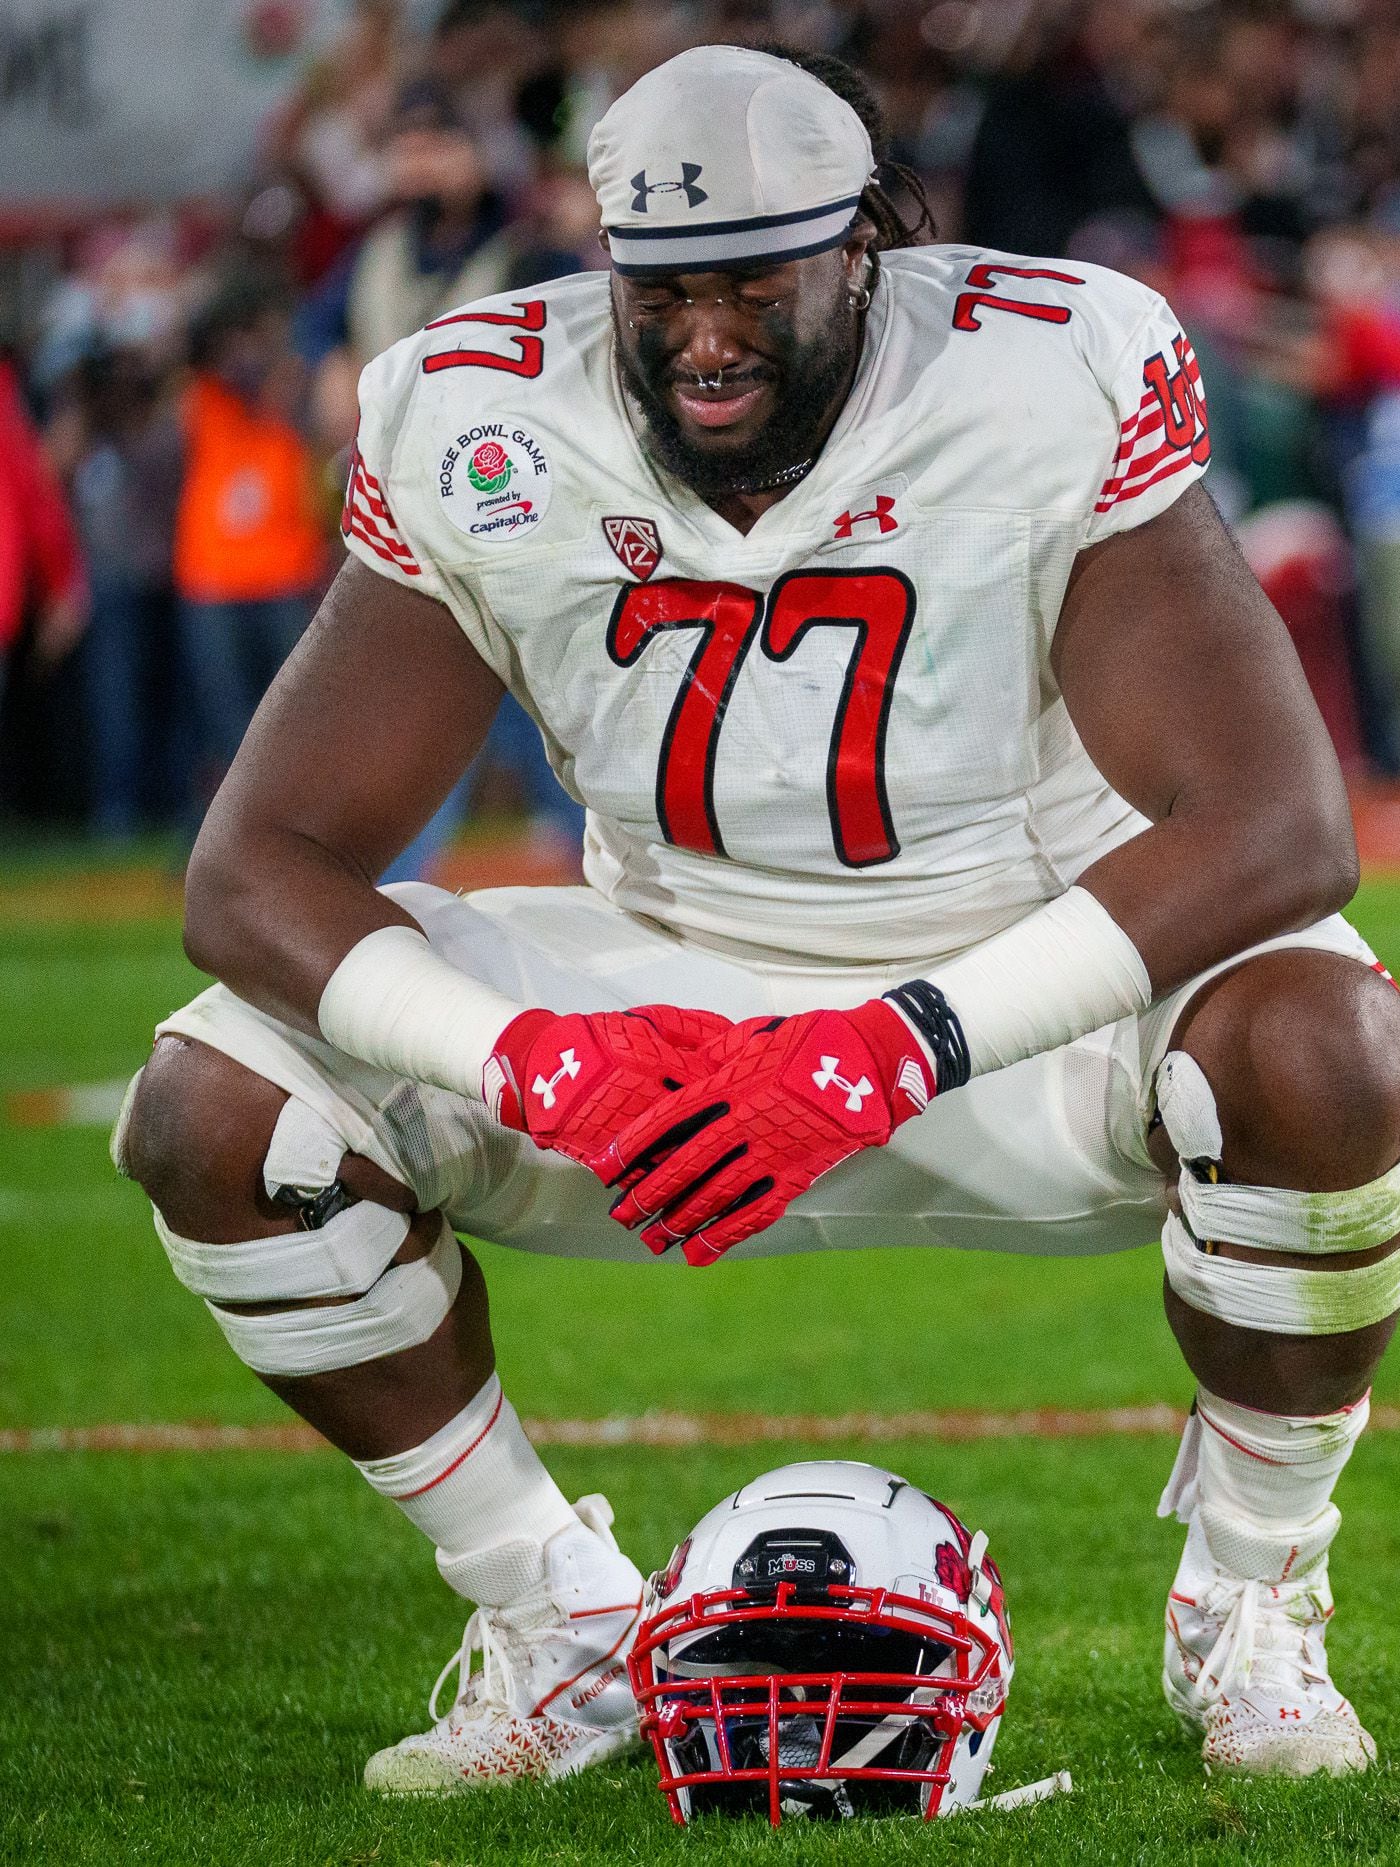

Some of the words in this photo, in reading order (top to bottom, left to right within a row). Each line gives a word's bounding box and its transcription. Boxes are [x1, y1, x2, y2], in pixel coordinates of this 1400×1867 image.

[952, 264, 1086, 332] 77
[422, 300, 547, 379] 77
[439, 447, 460, 497] ROSE
[456, 424, 509, 448] BOWL
[512, 430, 548, 475] GAME
[476, 491, 511, 511] presented
[511, 490, 521, 501] by
[604, 519, 658, 554] PAC
[624, 543, 653, 566] 12
[606, 566, 918, 869] 77
[768, 1557, 815, 1575] MUSS
